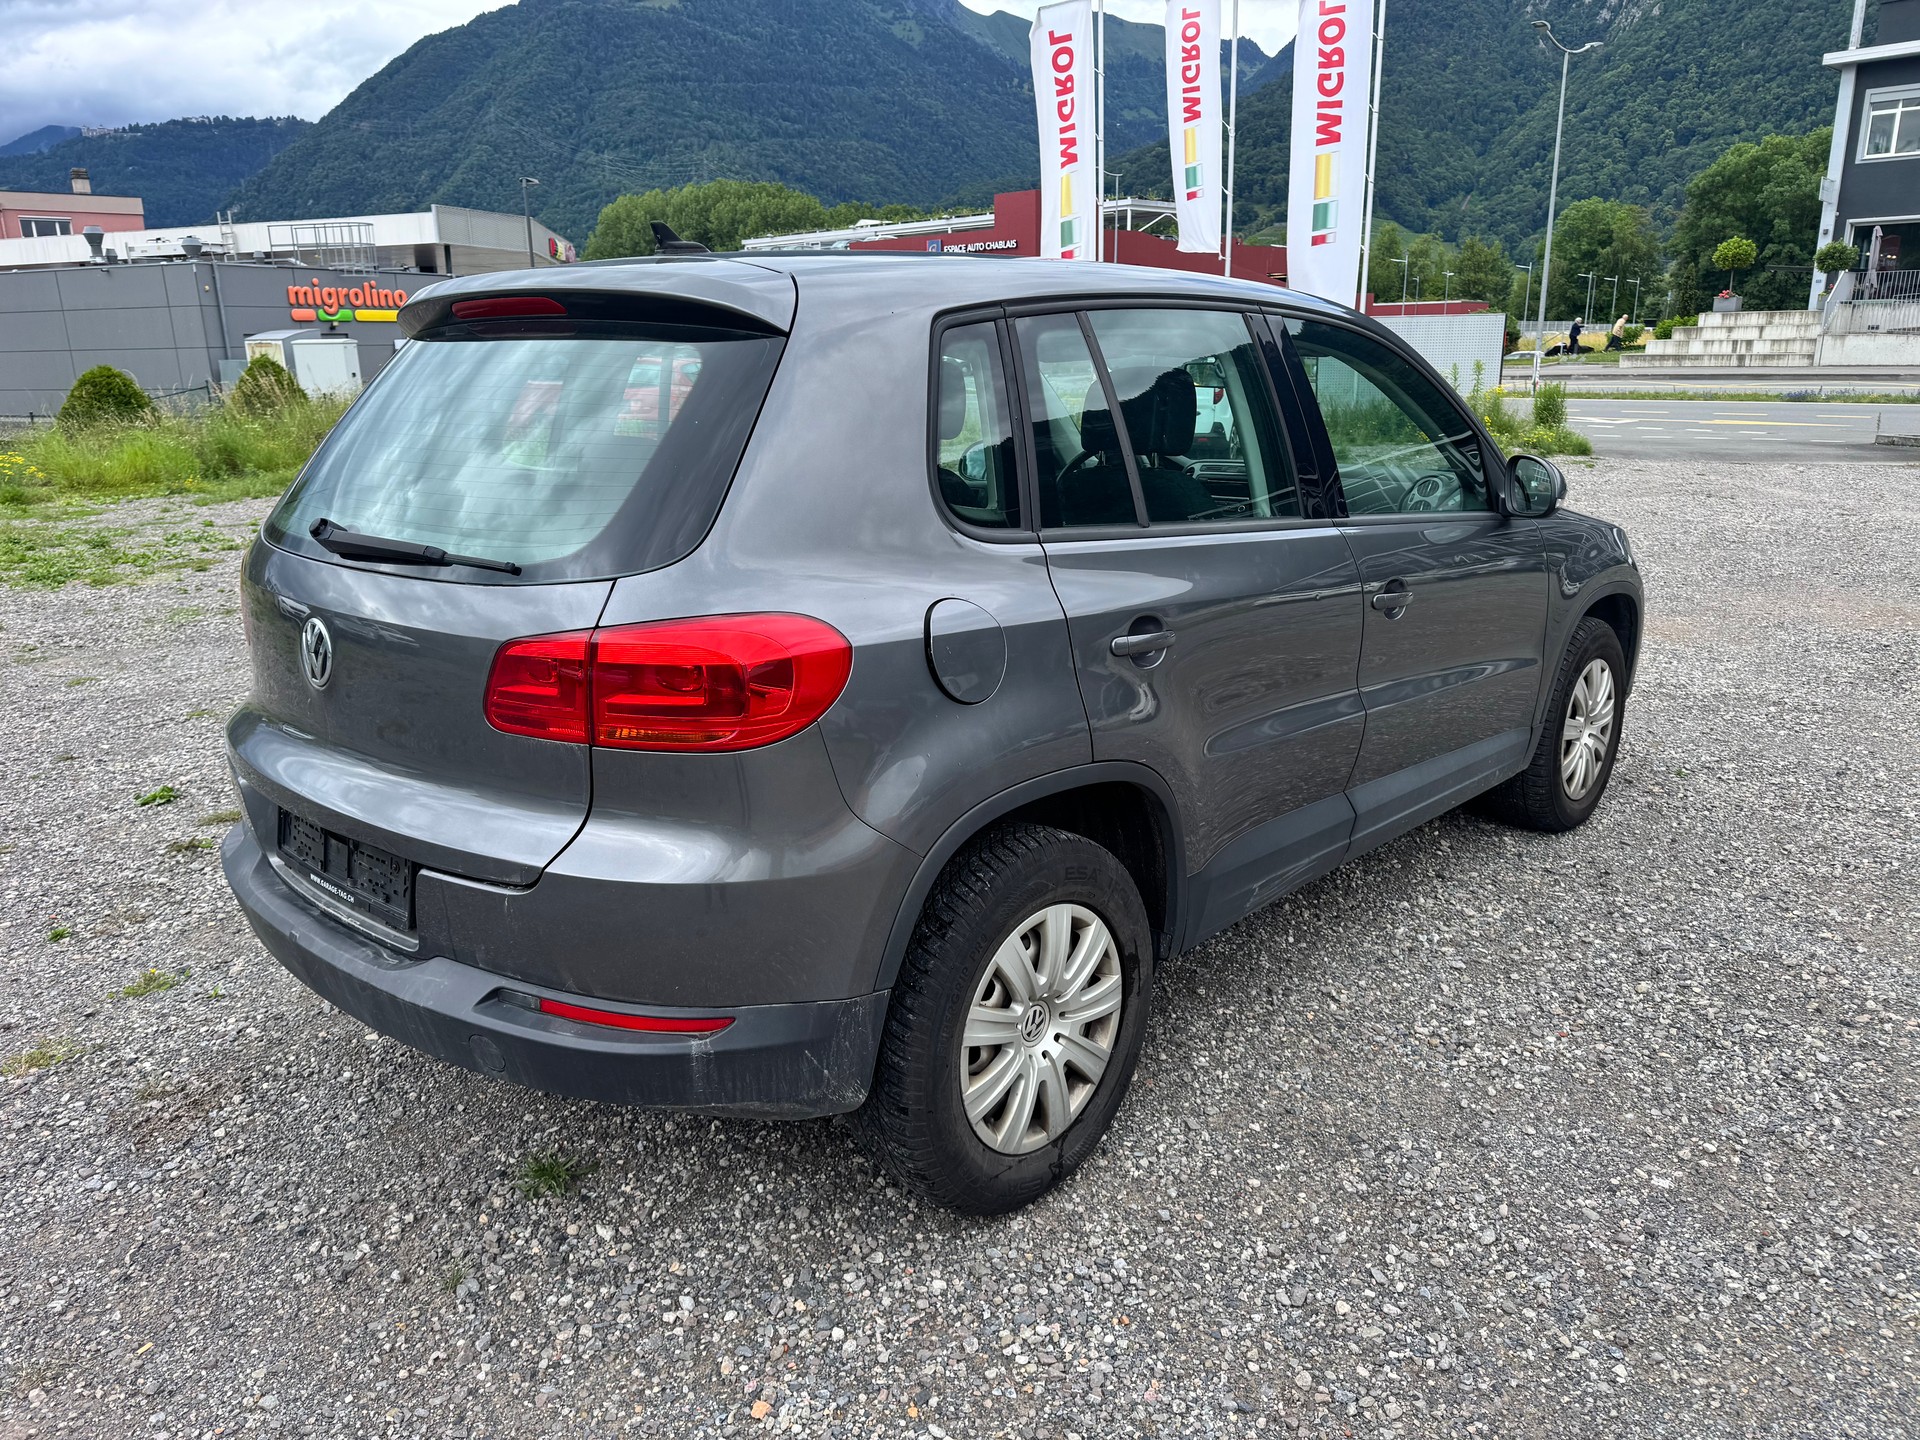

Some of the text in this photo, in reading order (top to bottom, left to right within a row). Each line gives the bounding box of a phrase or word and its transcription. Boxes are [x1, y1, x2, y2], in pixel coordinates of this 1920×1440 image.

[943, 239, 1017, 253] ESPACE AUTO CHABLAIS
[287, 277, 408, 315] migrolino
